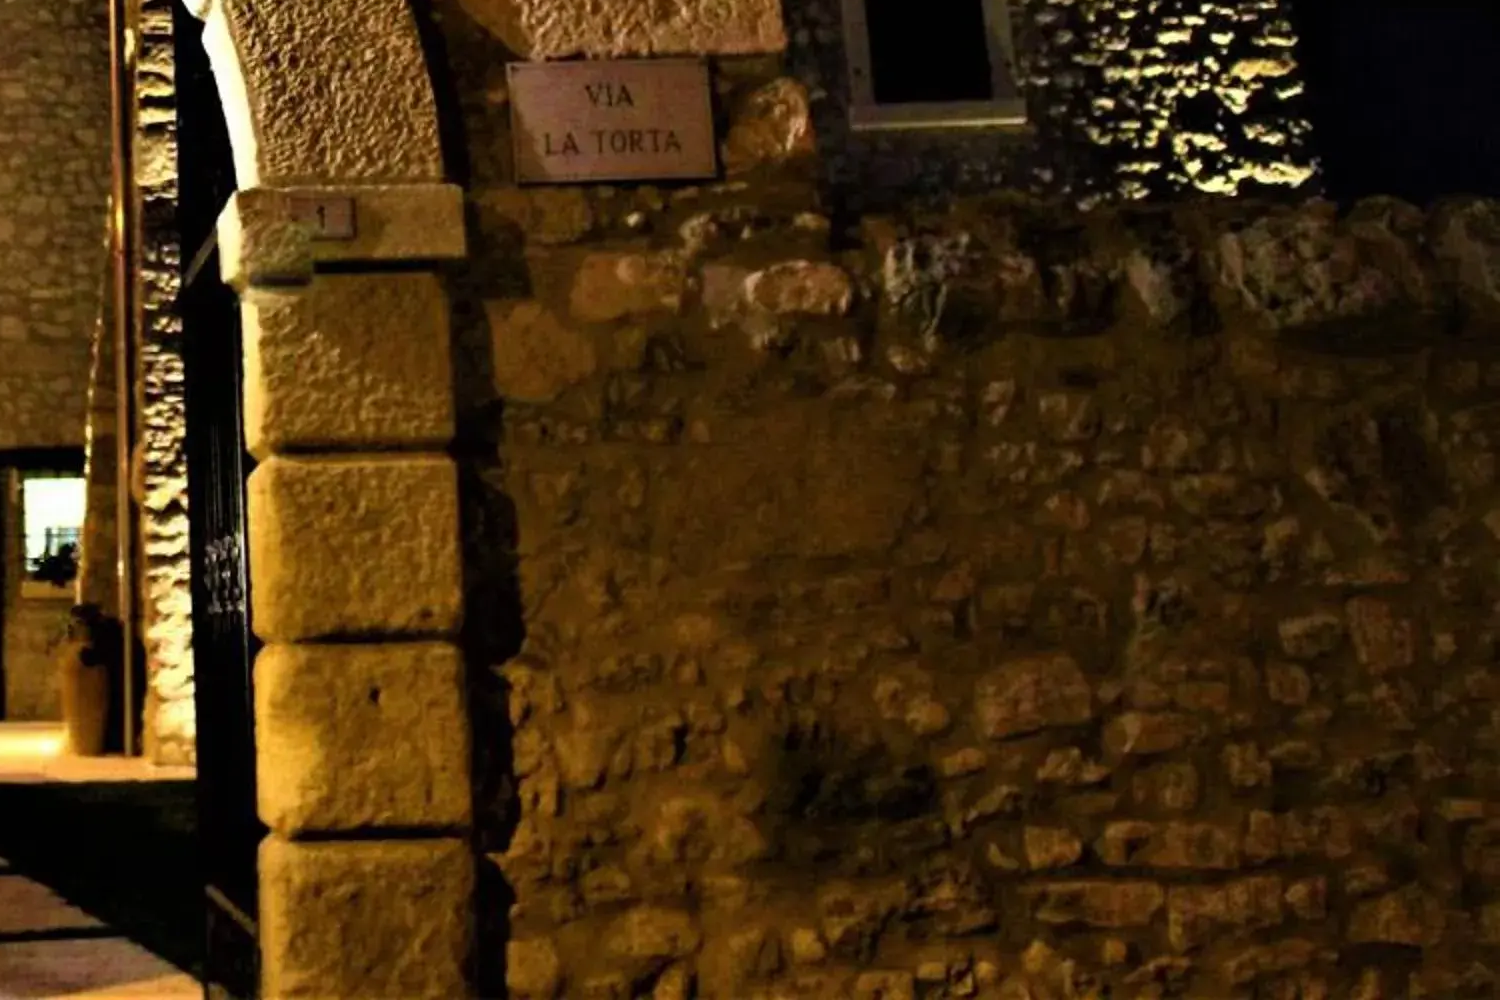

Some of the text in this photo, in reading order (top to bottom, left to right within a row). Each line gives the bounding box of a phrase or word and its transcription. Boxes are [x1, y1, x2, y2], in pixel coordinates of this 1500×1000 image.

[584, 82, 634, 107] VIA
[545, 128, 682, 156] LA TORTA
[315, 204, 326, 230] 1
